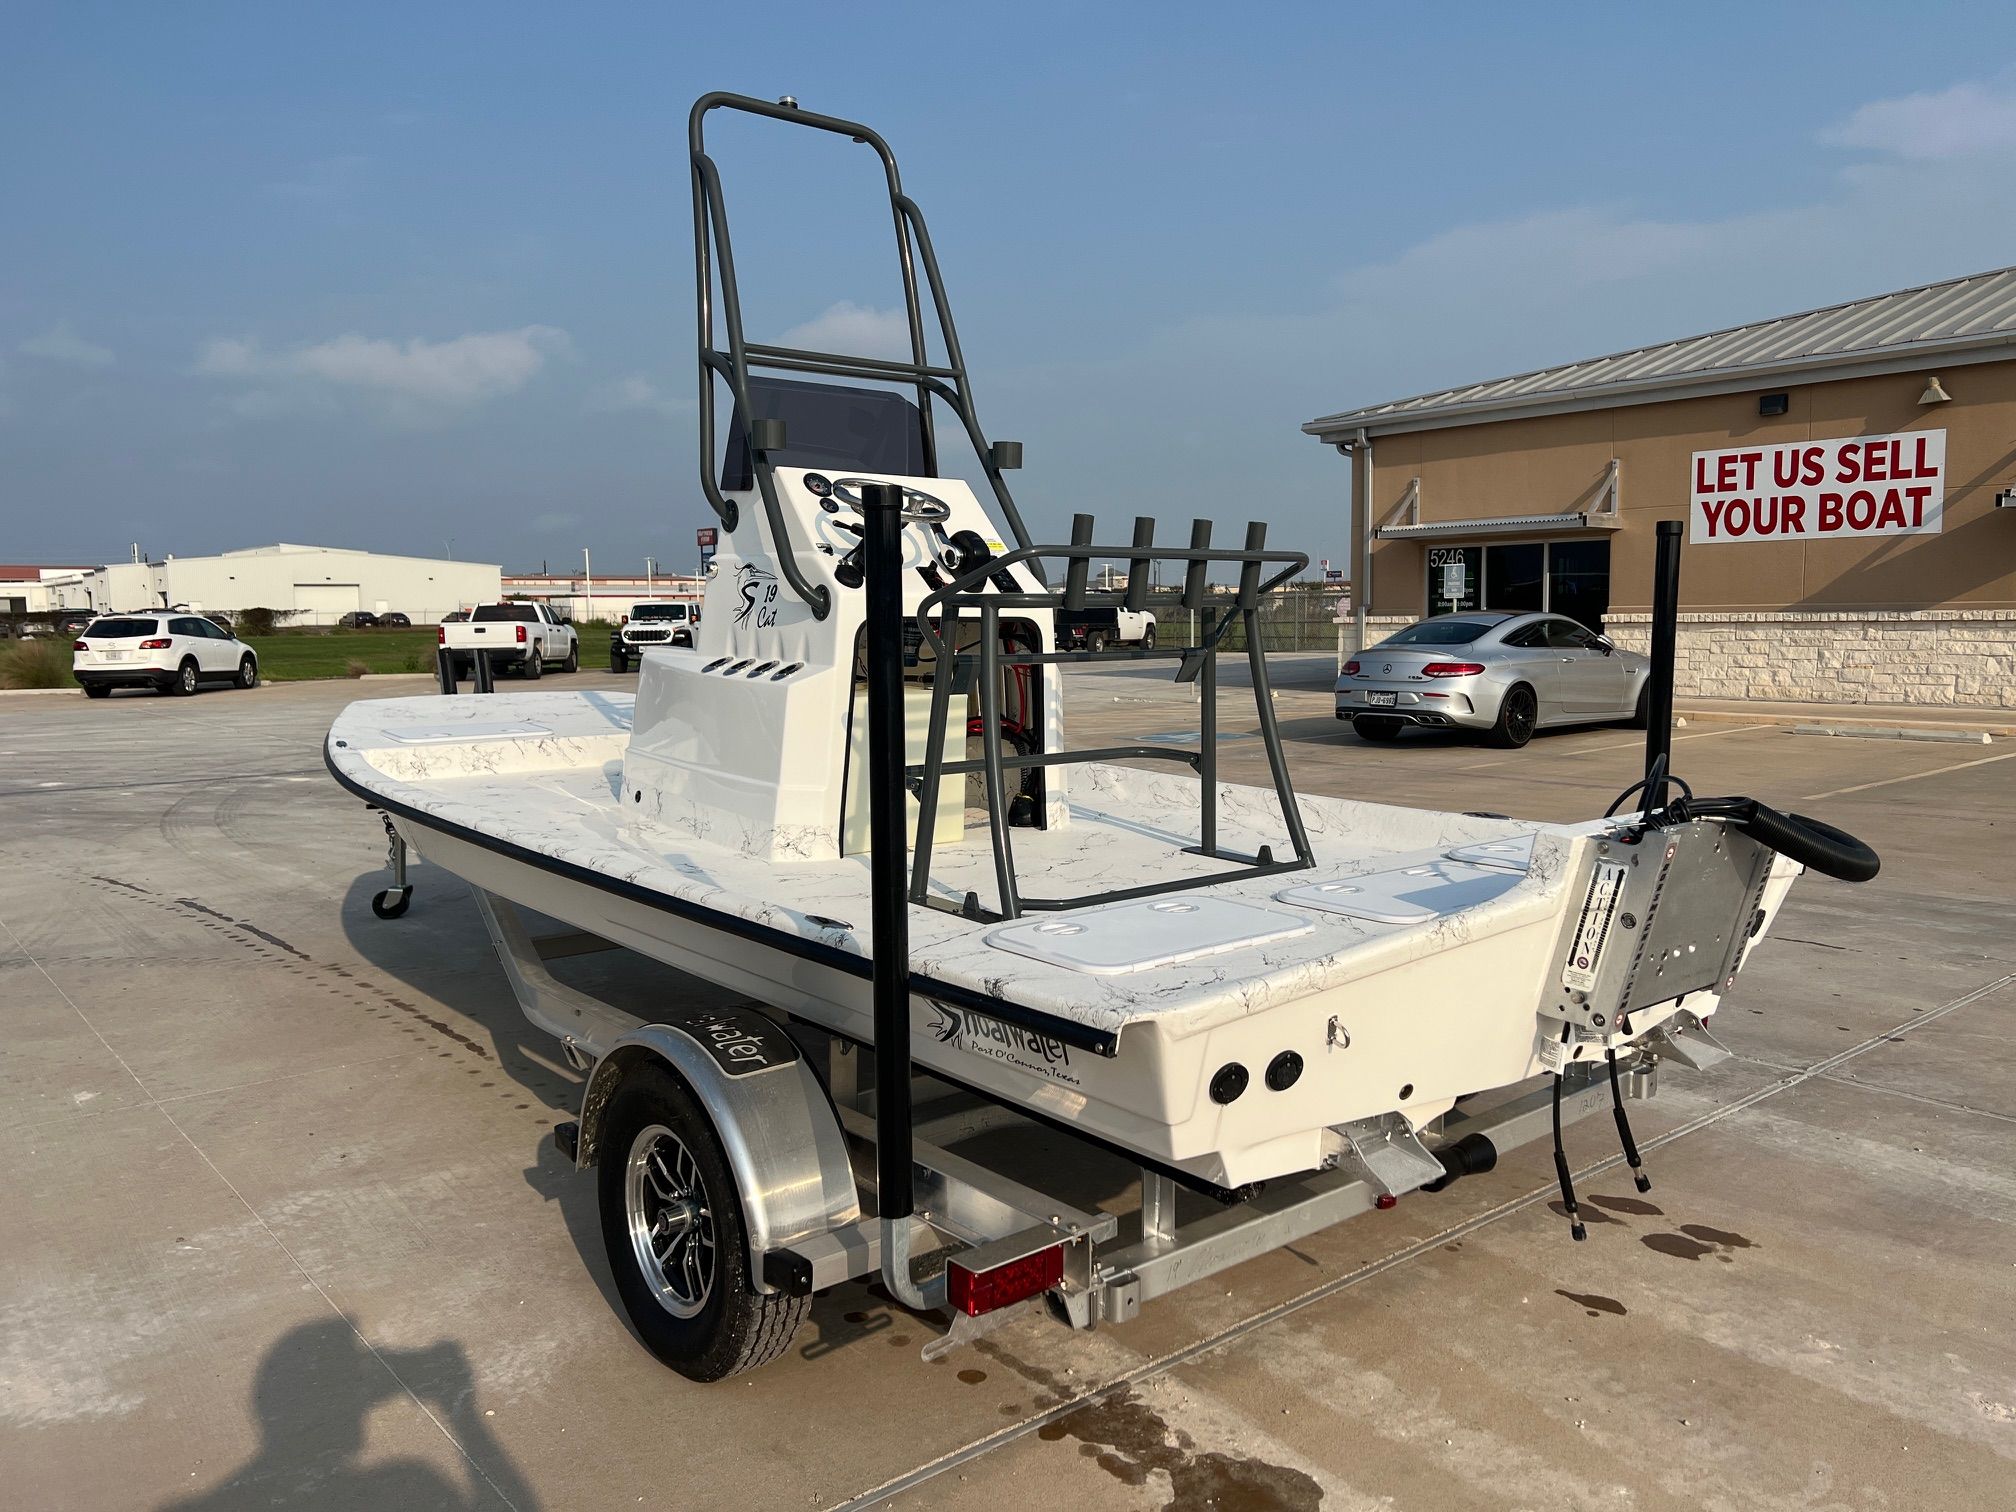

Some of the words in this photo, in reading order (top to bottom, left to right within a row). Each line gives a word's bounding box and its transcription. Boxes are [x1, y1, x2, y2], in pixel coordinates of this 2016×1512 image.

[1696, 452, 1763, 494] LET
[1773, 447, 1826, 489] US
[1835, 437, 1939, 484] SELL
[1700, 495, 1806, 538] YOUR
[1818, 486, 1932, 532] BOAT
[1430, 549, 1464, 568] 5246
[764, 584, 778, 603] 19
[757, 606, 778, 629] Cat
[1581, 867, 1612, 955] ACTION
[971, 1040, 994, 1056] Port
[1051, 1066, 1081, 1085] Texas
